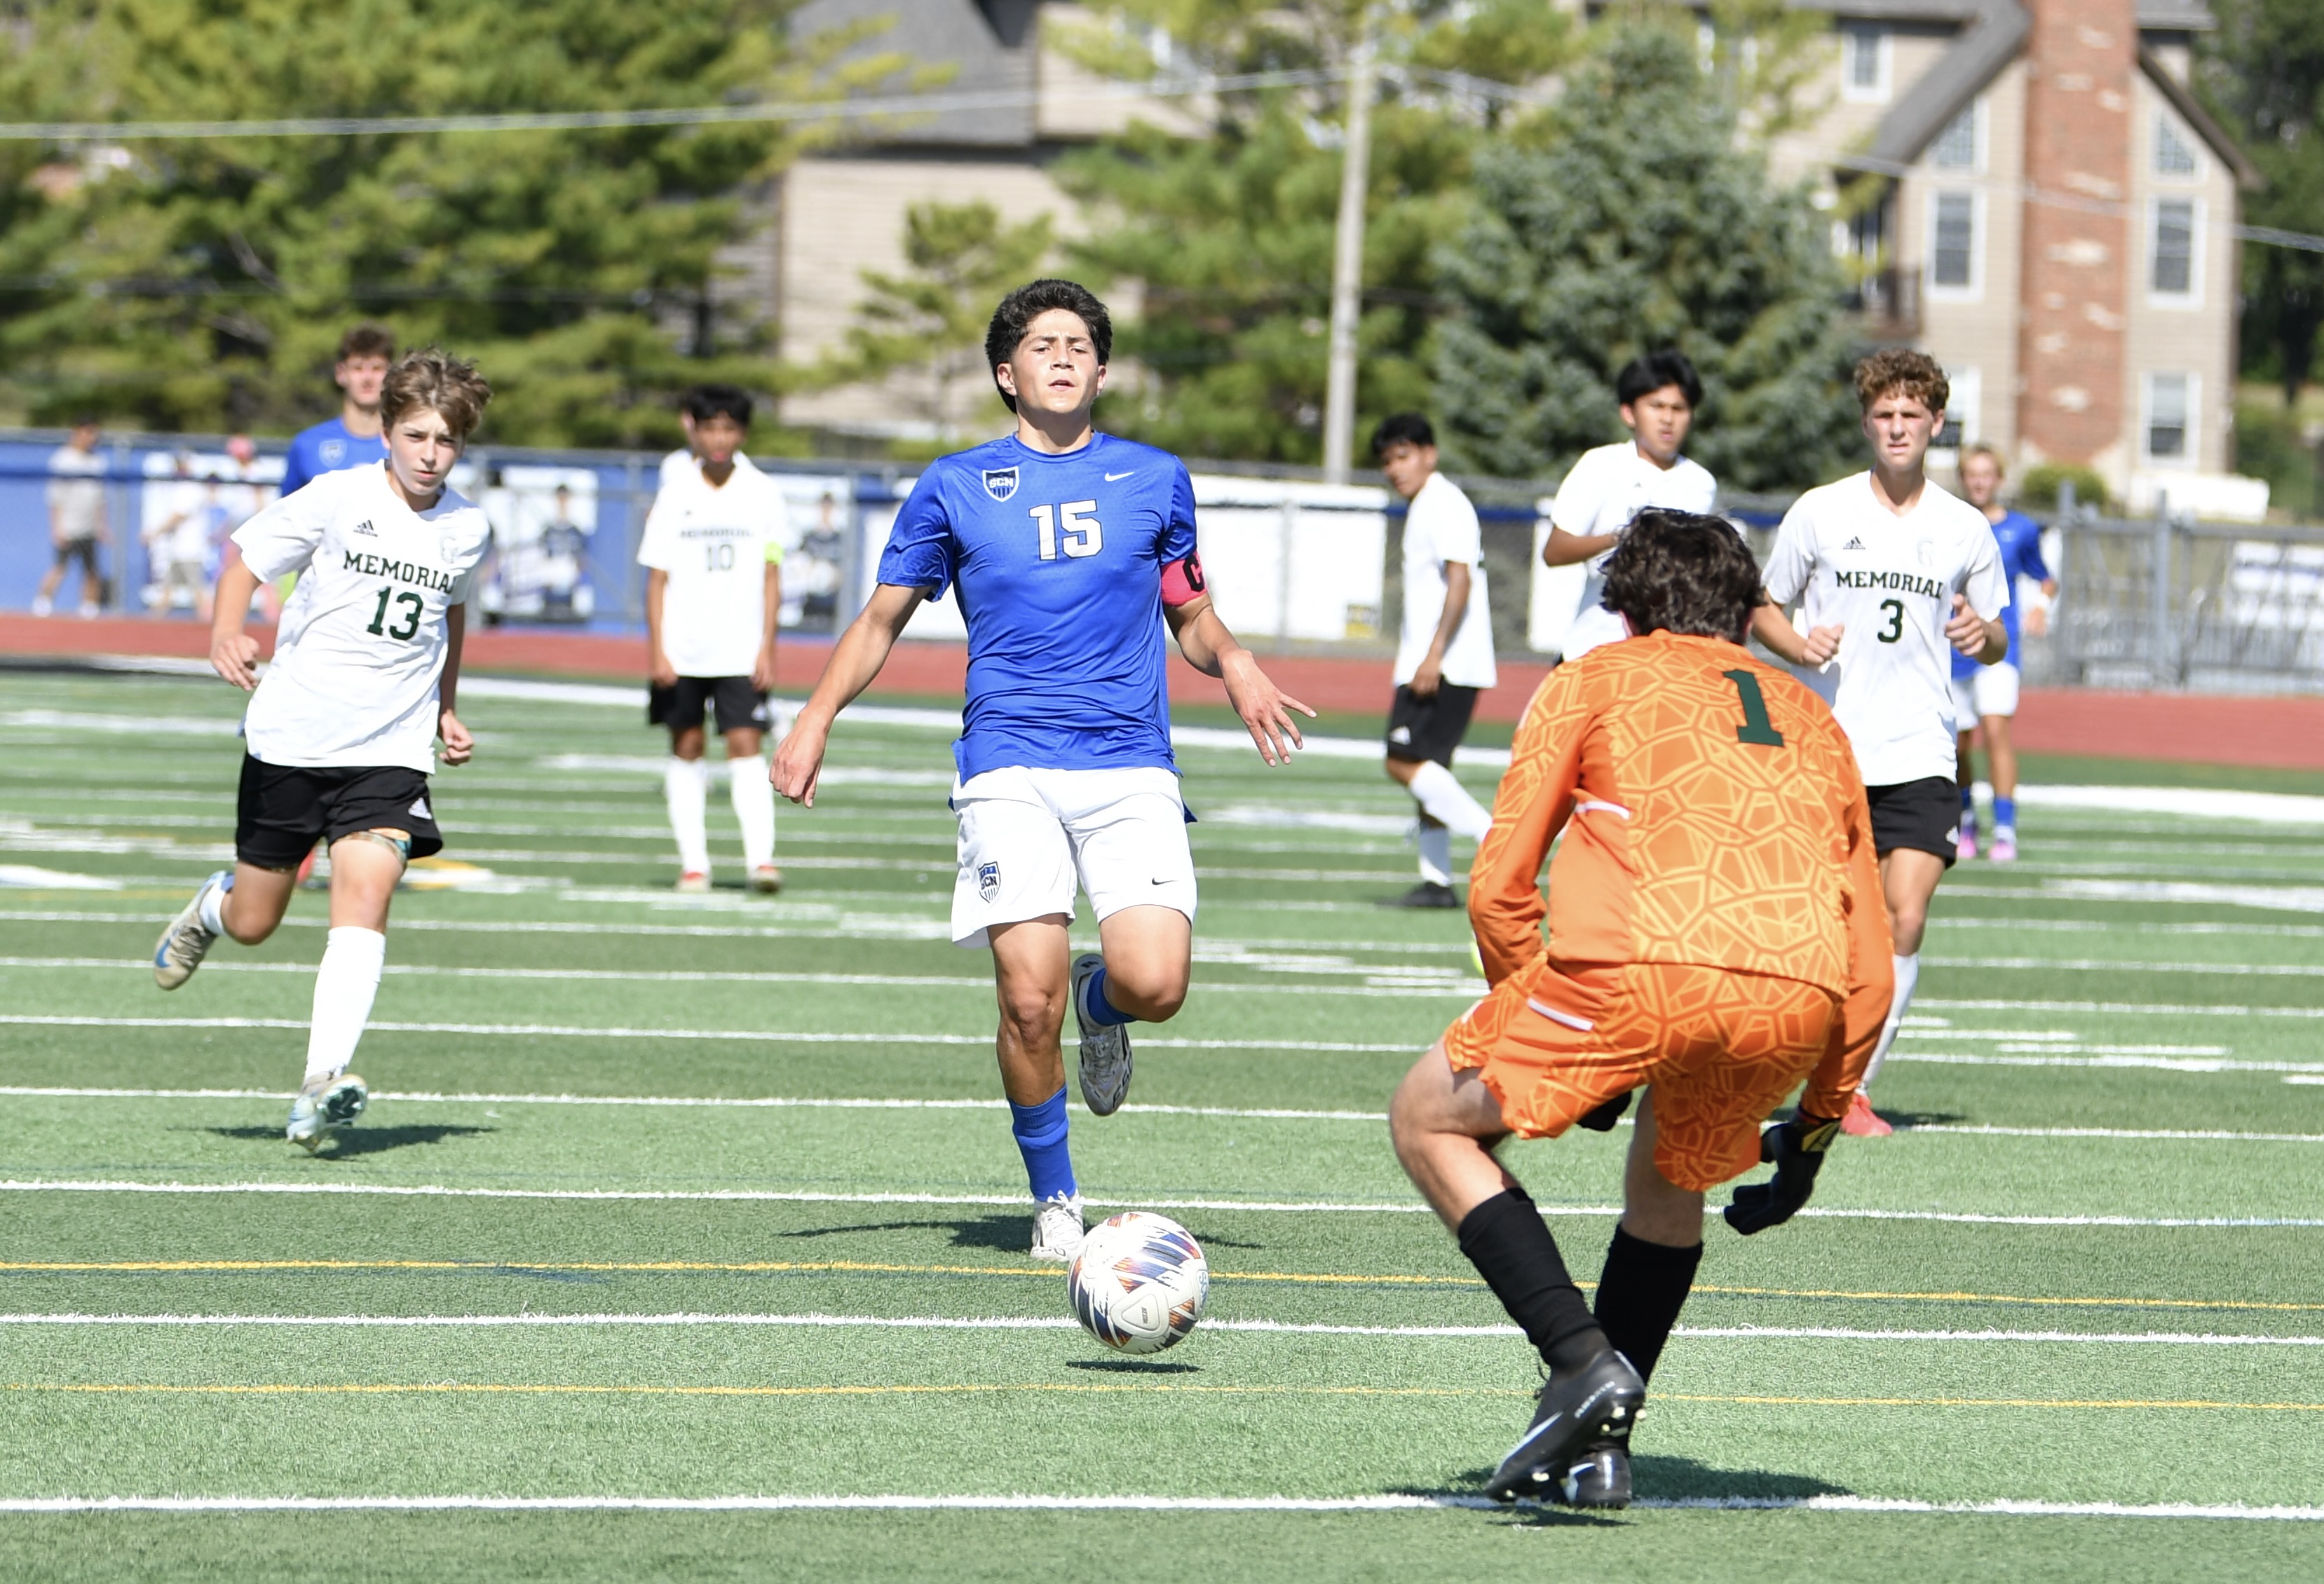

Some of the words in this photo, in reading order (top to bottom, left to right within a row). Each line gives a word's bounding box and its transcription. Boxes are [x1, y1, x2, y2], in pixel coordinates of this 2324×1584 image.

[988, 477, 1014, 489] SCN
[1028, 498, 1104, 561] 15
[707, 543, 735, 571] 10
[1182, 553, 1205, 593] C
[366, 585, 424, 641] 13
[1877, 599, 1904, 643] 3
[1721, 669, 1786, 748] 1
